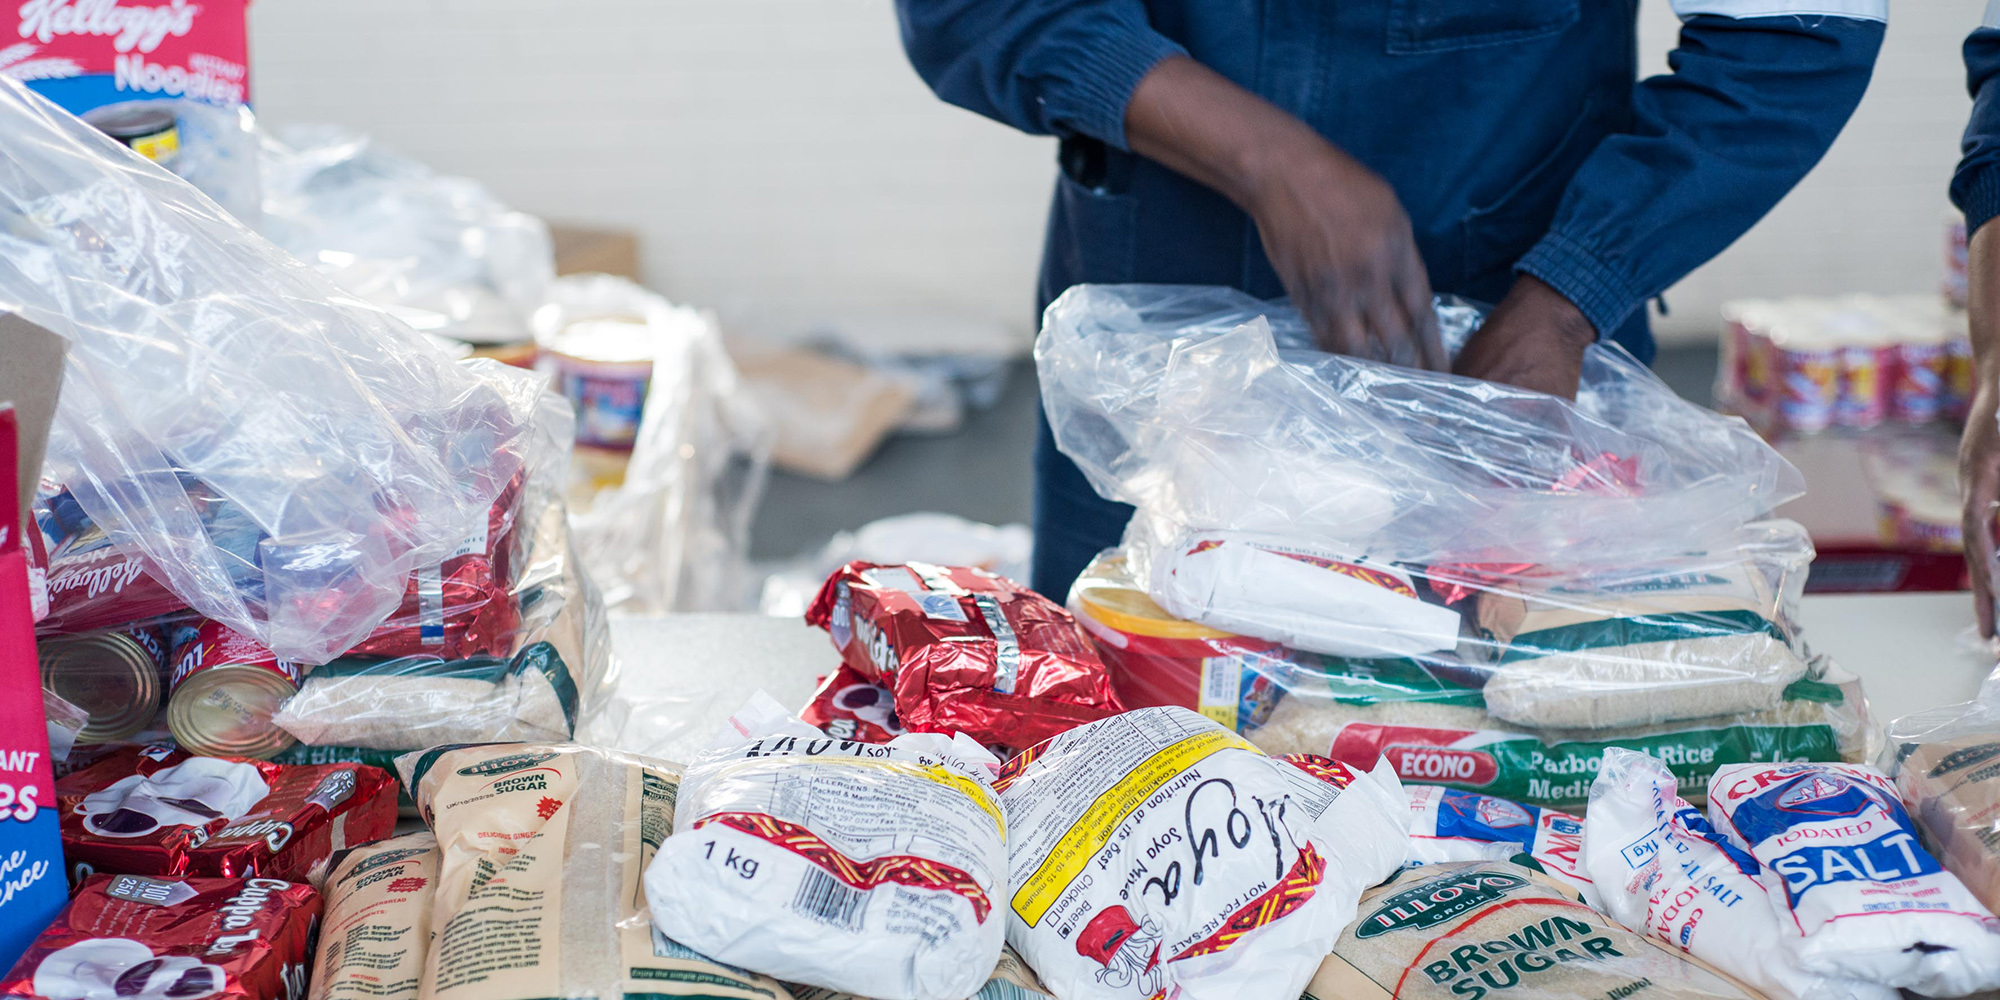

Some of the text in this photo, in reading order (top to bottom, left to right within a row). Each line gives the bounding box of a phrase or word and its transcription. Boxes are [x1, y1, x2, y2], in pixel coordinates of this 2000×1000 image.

[18, 0, 204, 53] Kellogg's
[115, 53, 244, 108] Noodles
[1174, 744, 1195, 759] soya
[1195, 741, 1206, 749] of
[1661, 745, 1716, 765] Rice
[1061, 749, 1103, 787] Manufactured
[1074, 765, 1092, 782] Soya
[1114, 747, 1156, 778] Ingredients:
[1154, 757, 1175, 772] stew
[1401, 752, 1476, 779] ECONO
[492, 773, 545, 790] BROWN
[495, 781, 547, 794] SUGAR
[813, 776, 869, 791] ALLERGENS:
[1087, 766, 1117, 795] Vegetable
[1136, 766, 1177, 798] Cooking
[1138, 769, 1156, 785] with
[811, 785, 841, 796] Packed
[851, 793, 905, 806] Manufactured
[1051, 785, 1061, 795] by
[1055, 781, 1076, 800] Beans
[1115, 782, 1139, 805] 750ml
[1527, 779, 1590, 800] Medi
[1028, 735, 1202, 887] boil while stirring, allow to simmer for +/- 10 minutes
[1107, 801, 1117, 813] of
[1039, 815, 1066, 846] Vegetable
[1095, 768, 1202, 872] Nutrition at its Best
[478, 830, 512, 841] DELICIOUS
[1026, 828, 1039, 842] and
[1073, 831, 1090, 851] soak
[1145, 826, 1183, 859] Soya
[1776, 820, 1873, 848] IODATED
[1063, 849, 1075, 861] for
[1631, 837, 1660, 858] 1kg
[704, 840, 760, 879] 1 kg
[1010, 856, 1033, 879] Vitamin
[1027, 852, 1045, 872] Maize
[1775, 833, 1922, 895] SALT
[354, 870, 404, 892] SUGAR
[356, 865, 405, 886] BROWN
[1045, 860, 1065, 883] 10-15
[141, 882, 173, 902] 100
[1054, 872, 1094, 915] Chicken
[1901, 879, 1919, 888] FOR
[1911, 887, 1942, 898] WORKS
[222, 877, 293, 930] Cuppa
[1374, 876, 1515, 928] ILLOVO
[1433, 895, 1485, 920] GROUP
[1067, 899, 1092, 928] Beef
[1171, 880, 1267, 956] NOT FOR RE-SALE
[1423, 916, 1593, 985] BROWN
[632, 969, 654, 979] Enjoy
[655, 970, 667, 978] the
[670, 971, 697, 980] simple
[1451, 937, 1624, 1000] SUGAR
